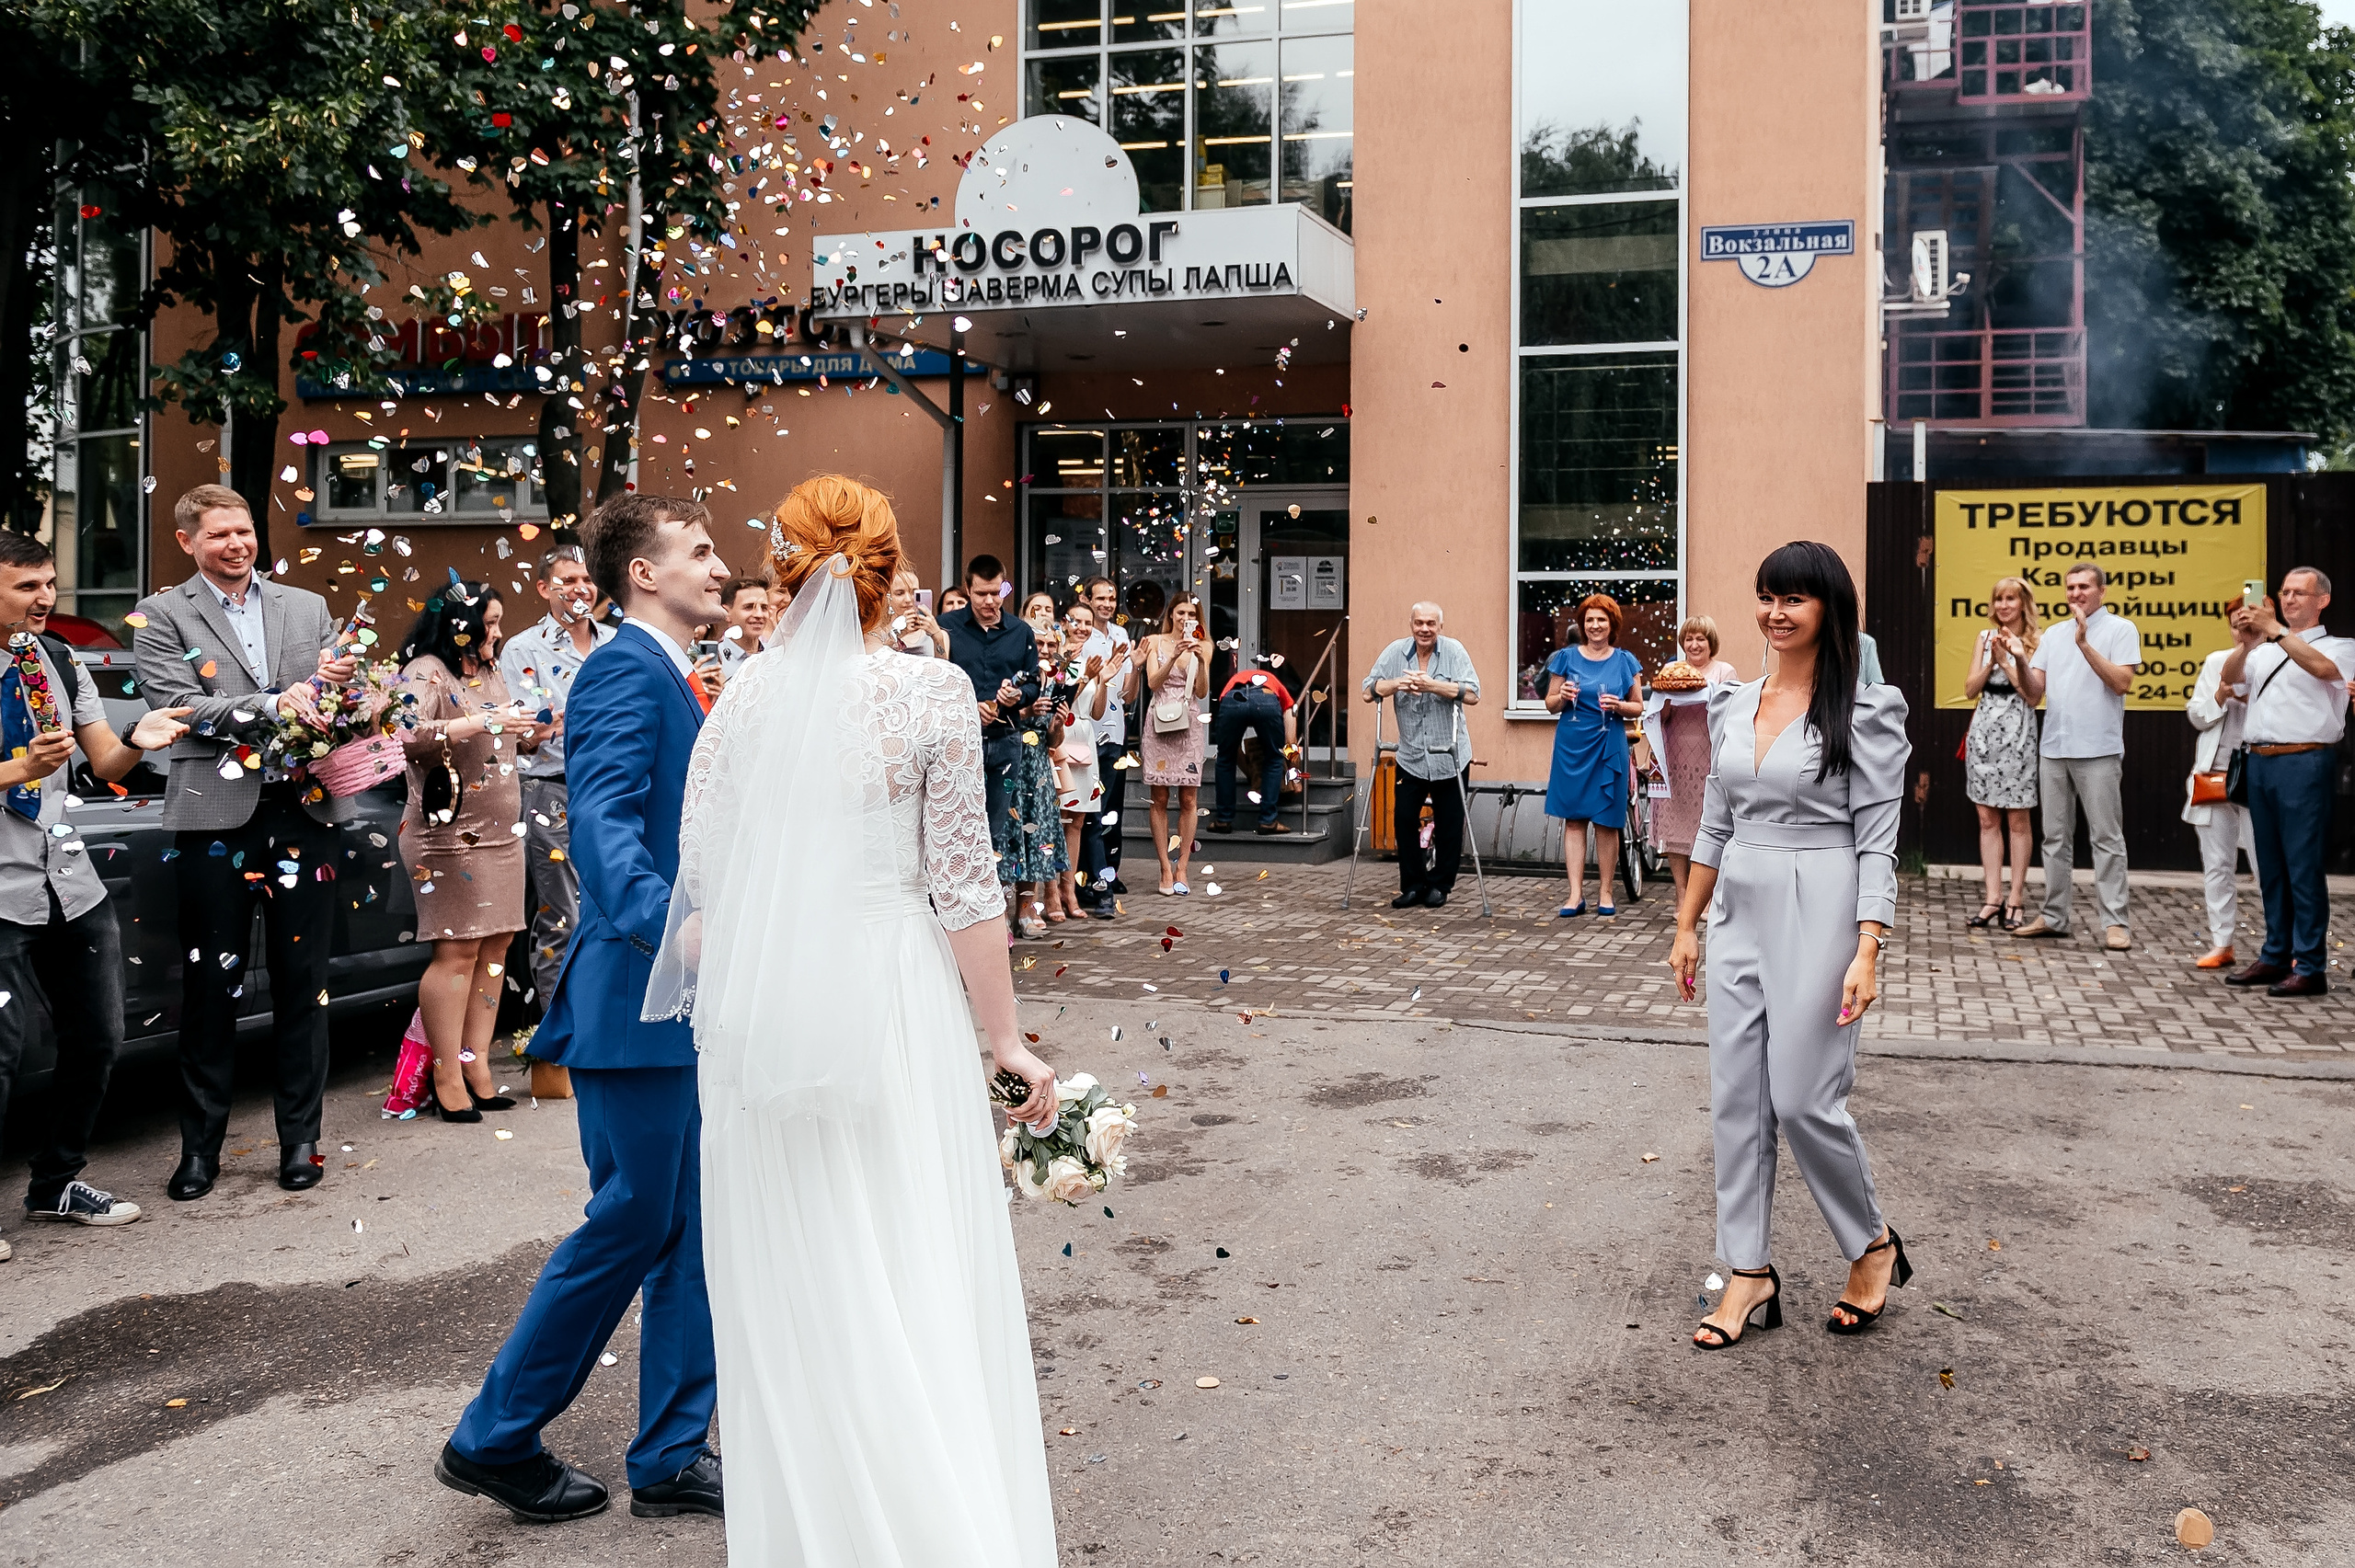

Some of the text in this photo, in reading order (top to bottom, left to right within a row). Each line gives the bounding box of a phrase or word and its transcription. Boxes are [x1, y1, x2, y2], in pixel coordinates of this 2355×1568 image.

[1708, 233, 1847, 254] Вокзальная
[1752, 227, 1801, 237] улица
[912, 222, 1179, 274] НОСОРОГ
[1756, 255, 1797, 279] 2А
[810, 261, 1294, 309] БУРГЕРЫ ШАВЕРМА СУПЫ ЛАПША
[812, 357, 853, 375] ДЛЯ
[858, 355, 916, 374] ДМА
[1959, 498, 2242, 529] ТРЕБУЮТСЯ
[2009, 537, 2188, 560] Продавцы
[2022, 567, 2176, 589] Каиры
